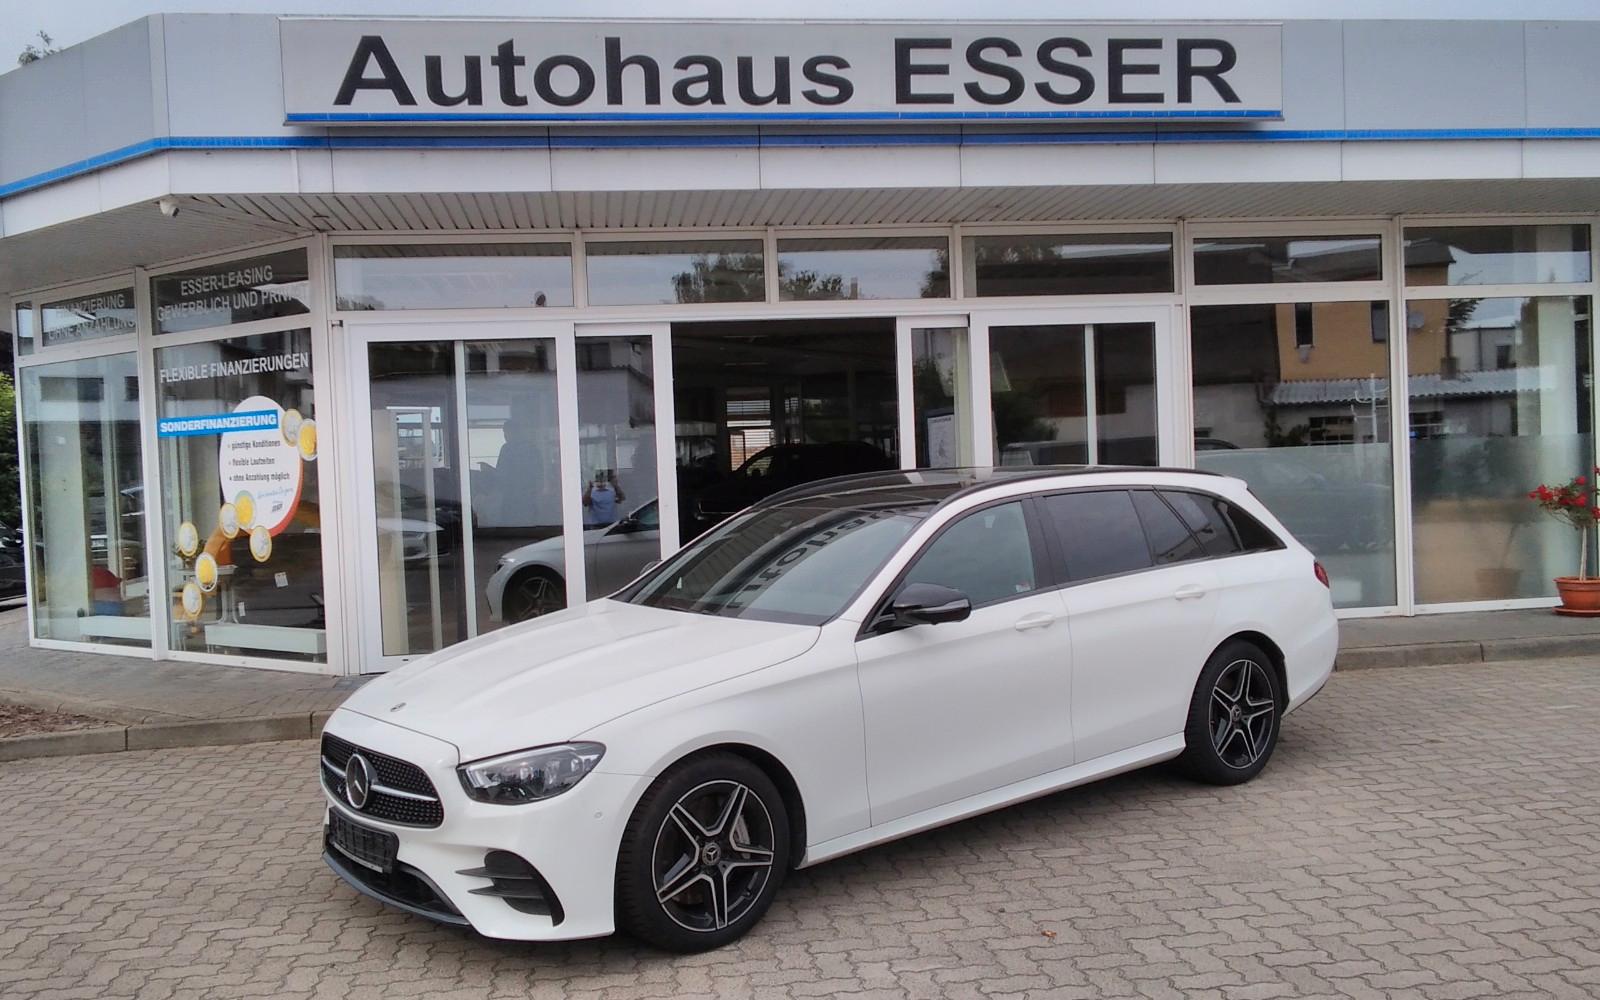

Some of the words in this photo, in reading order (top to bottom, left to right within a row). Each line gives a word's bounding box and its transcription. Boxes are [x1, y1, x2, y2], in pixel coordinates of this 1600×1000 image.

[333, 35, 854, 107] Autohaus
[894, 37, 1242, 105] ESSER
[180, 264, 273, 296] ESSER-LEASING
[55, 293, 125, 317] NANZIERUNG
[232, 290, 259, 310] UND
[159, 363, 209, 384] FLEXIBLE
[210, 352, 309, 378] FINANZIERUNGEN
[160, 413, 277, 433] SONDERFINANZIERUNG
